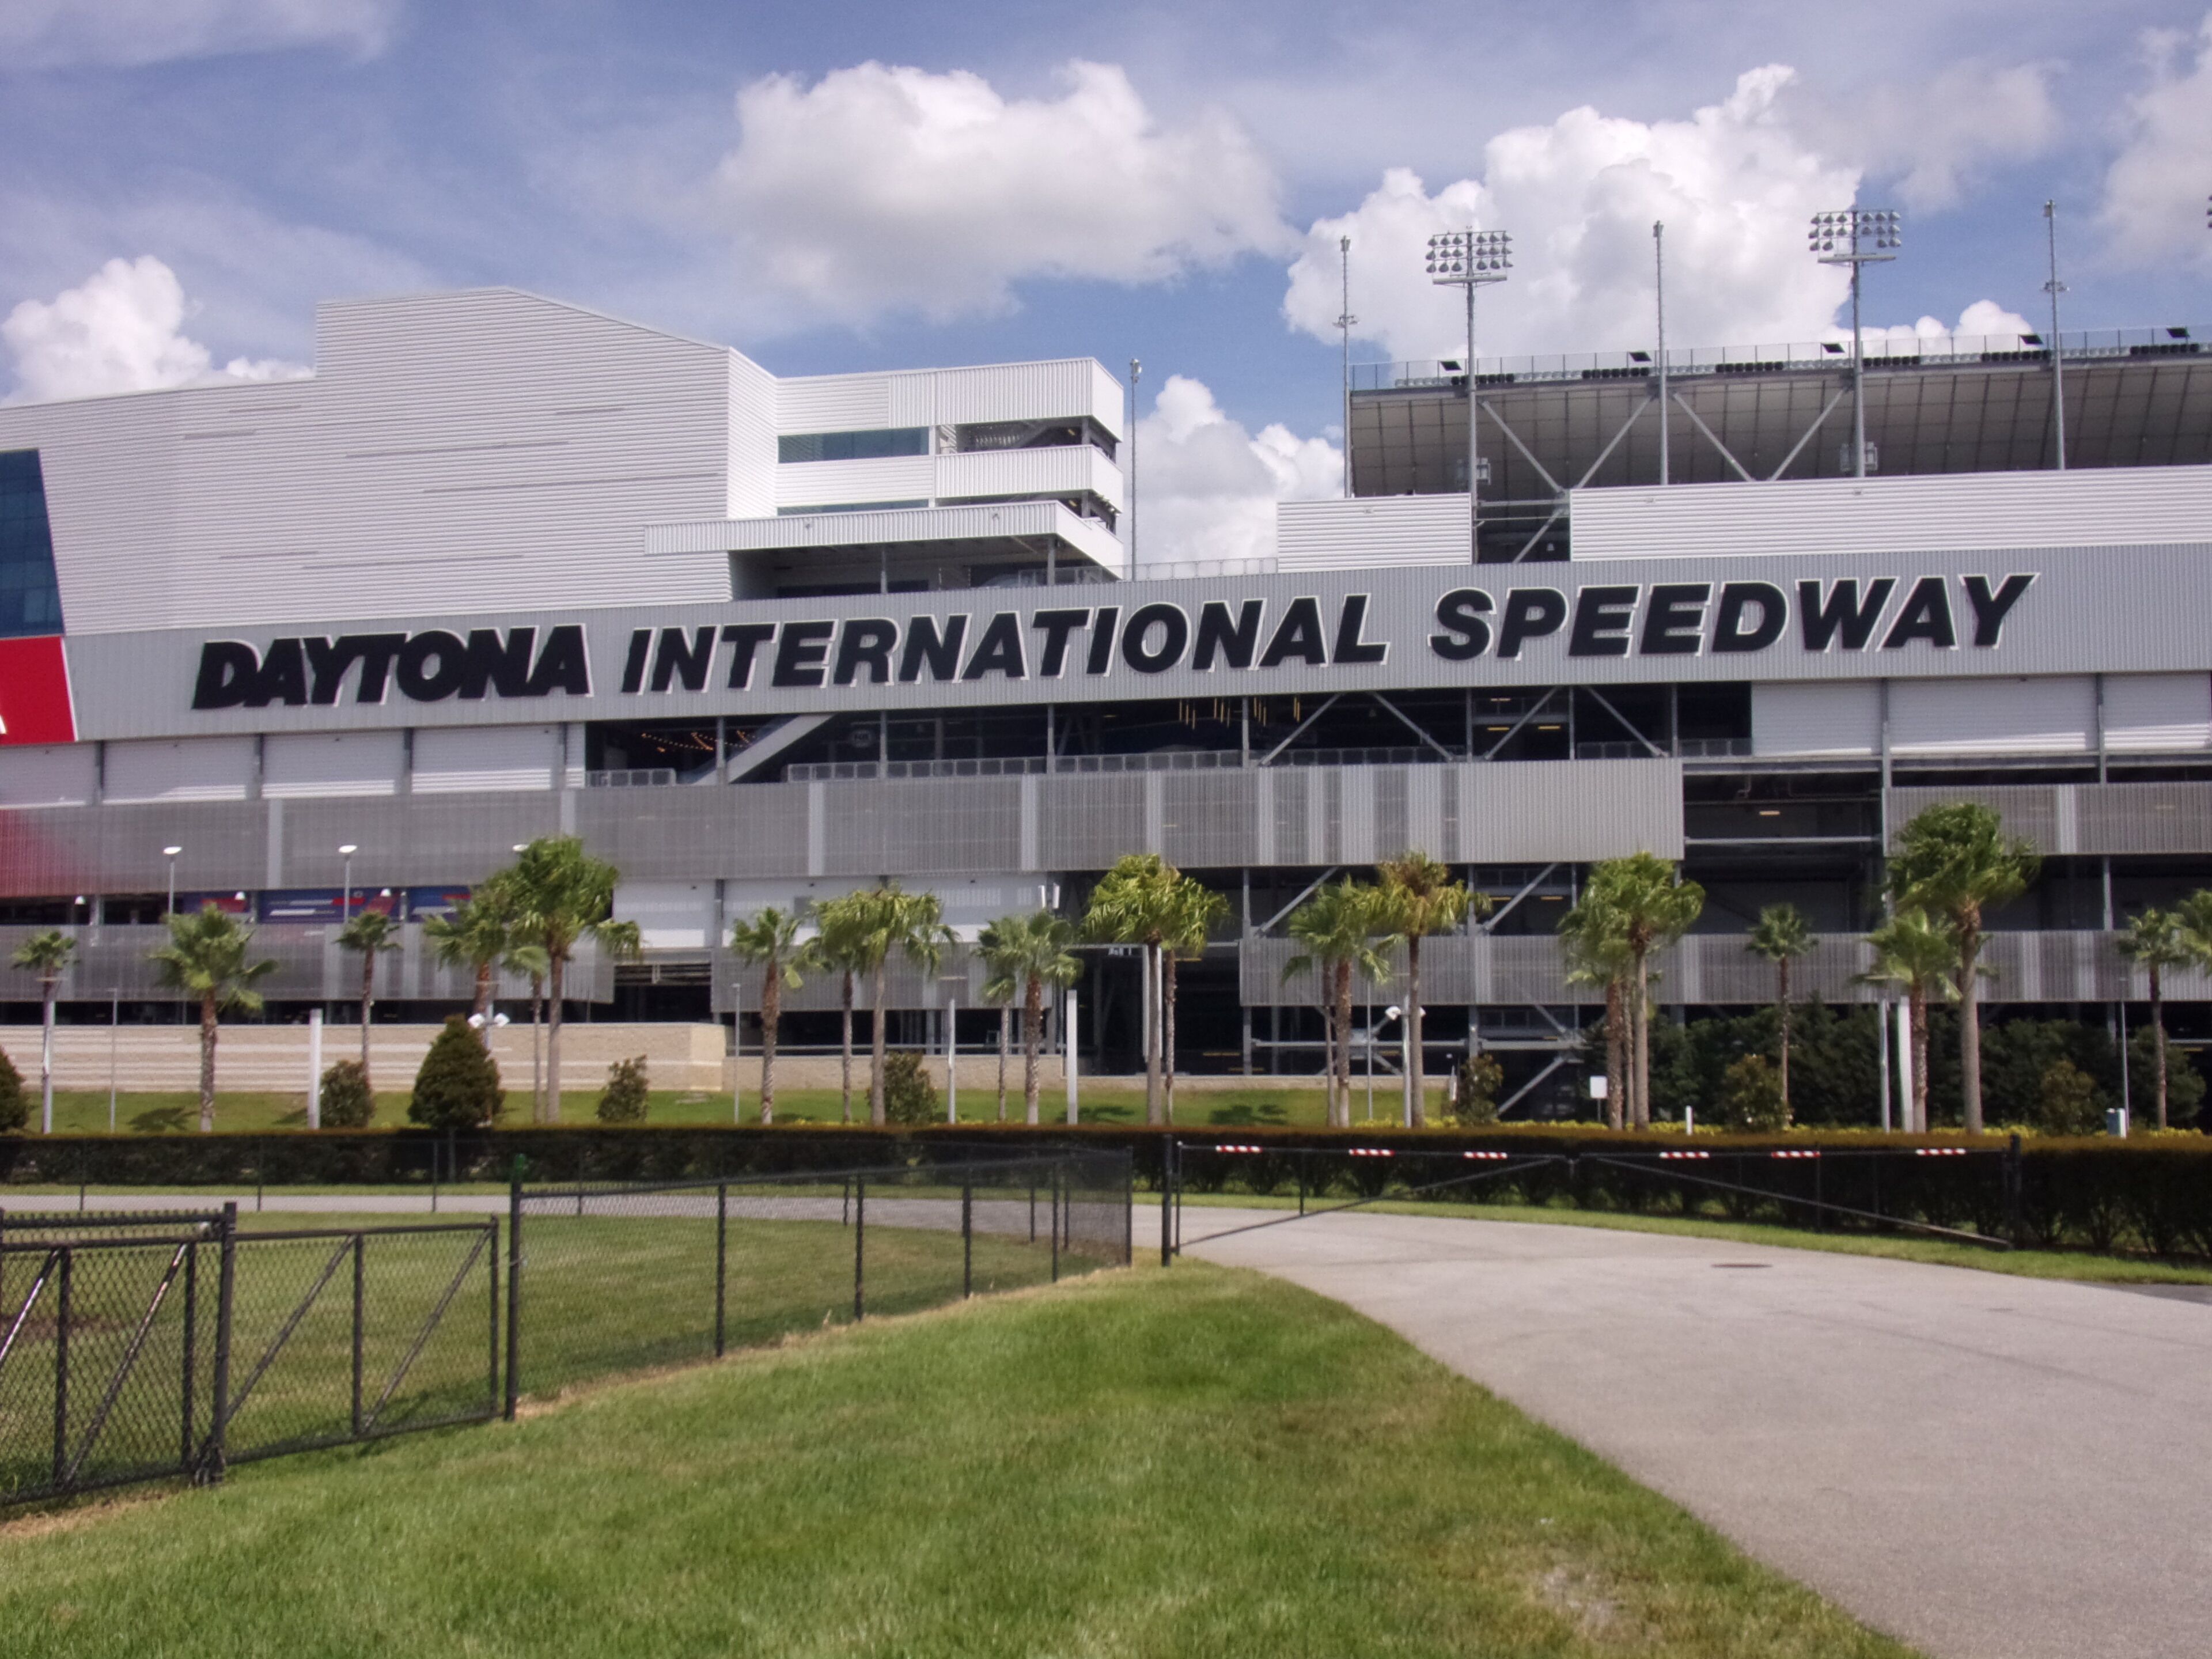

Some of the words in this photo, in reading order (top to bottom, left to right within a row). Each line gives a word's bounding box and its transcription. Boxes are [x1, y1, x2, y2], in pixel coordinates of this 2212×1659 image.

[192, 624, 593, 710] DAYTONA
[621, 593, 1389, 695] INTERNATIONAL
[1429, 573, 2039, 661] SPEEDWAY
